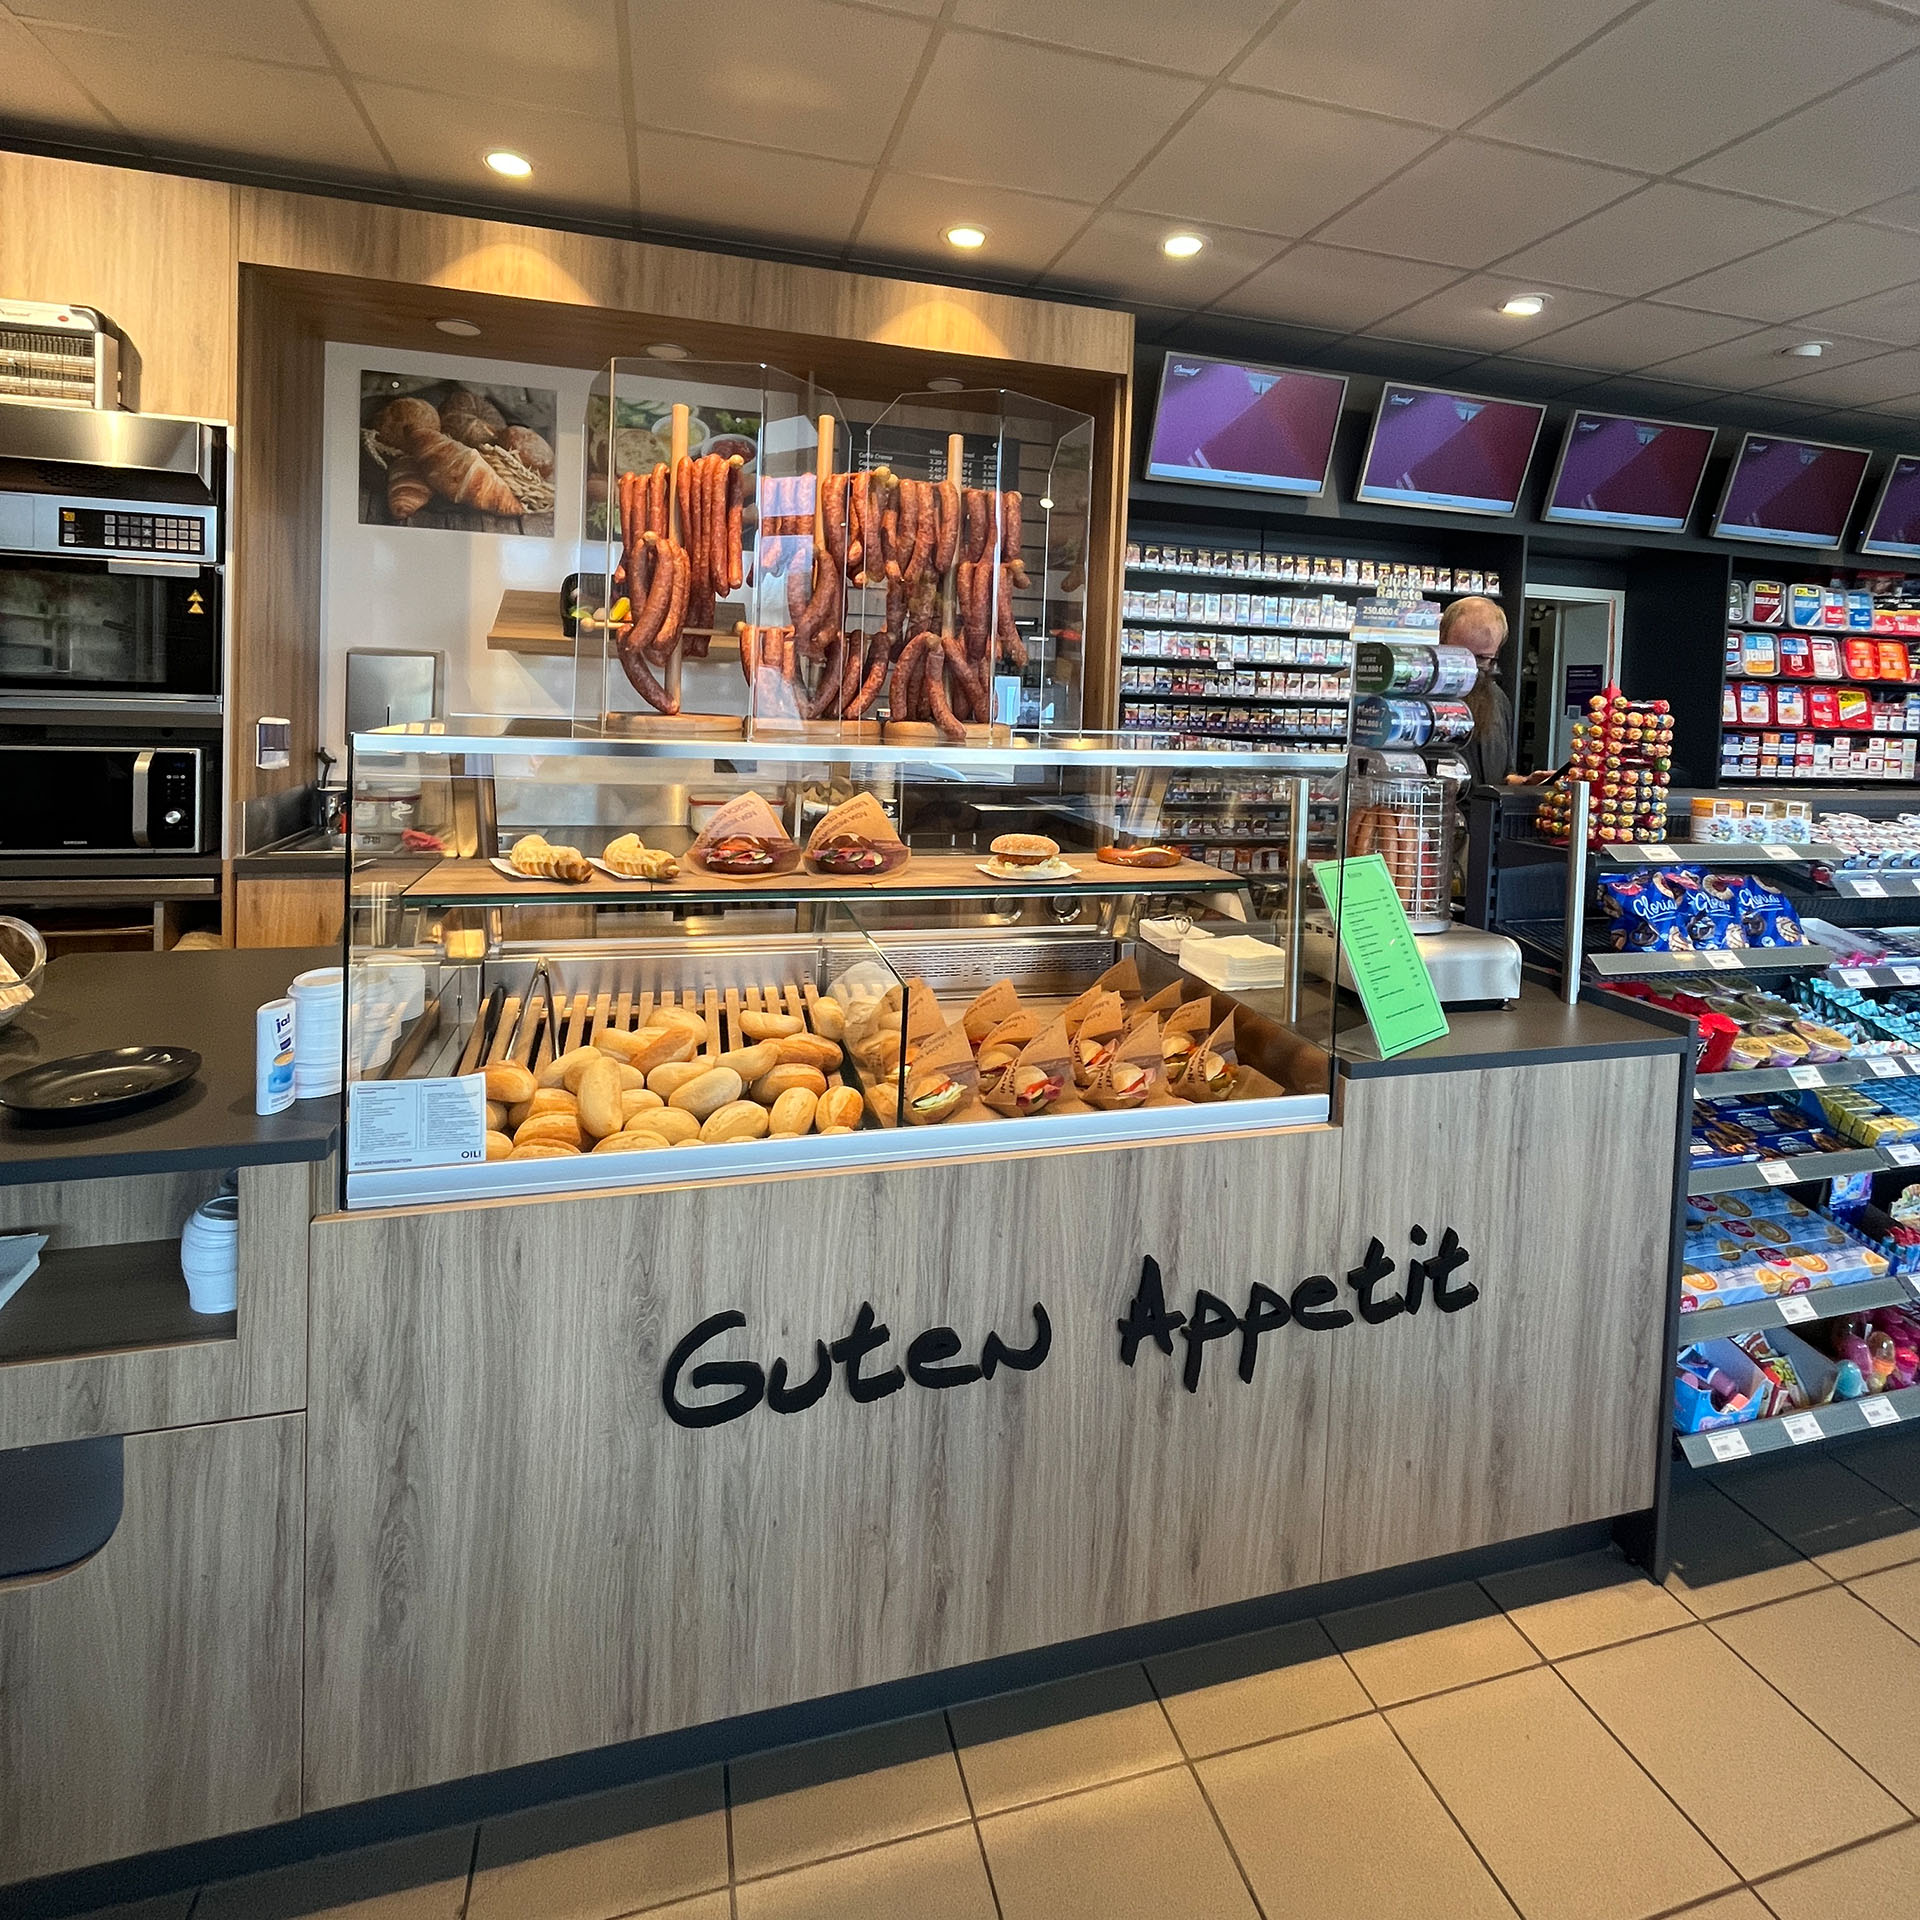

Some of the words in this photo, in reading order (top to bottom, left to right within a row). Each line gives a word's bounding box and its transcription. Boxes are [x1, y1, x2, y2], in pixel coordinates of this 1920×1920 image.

[1380, 573, 1422, 589] Glücks
[1376, 585, 1423, 600] Rakete
[1633, 896, 1678, 918] Gloria
[1738, 888, 1780, 908] Gloria
[662, 1301, 1052, 1429] Guten
[1118, 1224, 1481, 1394] Appetit
